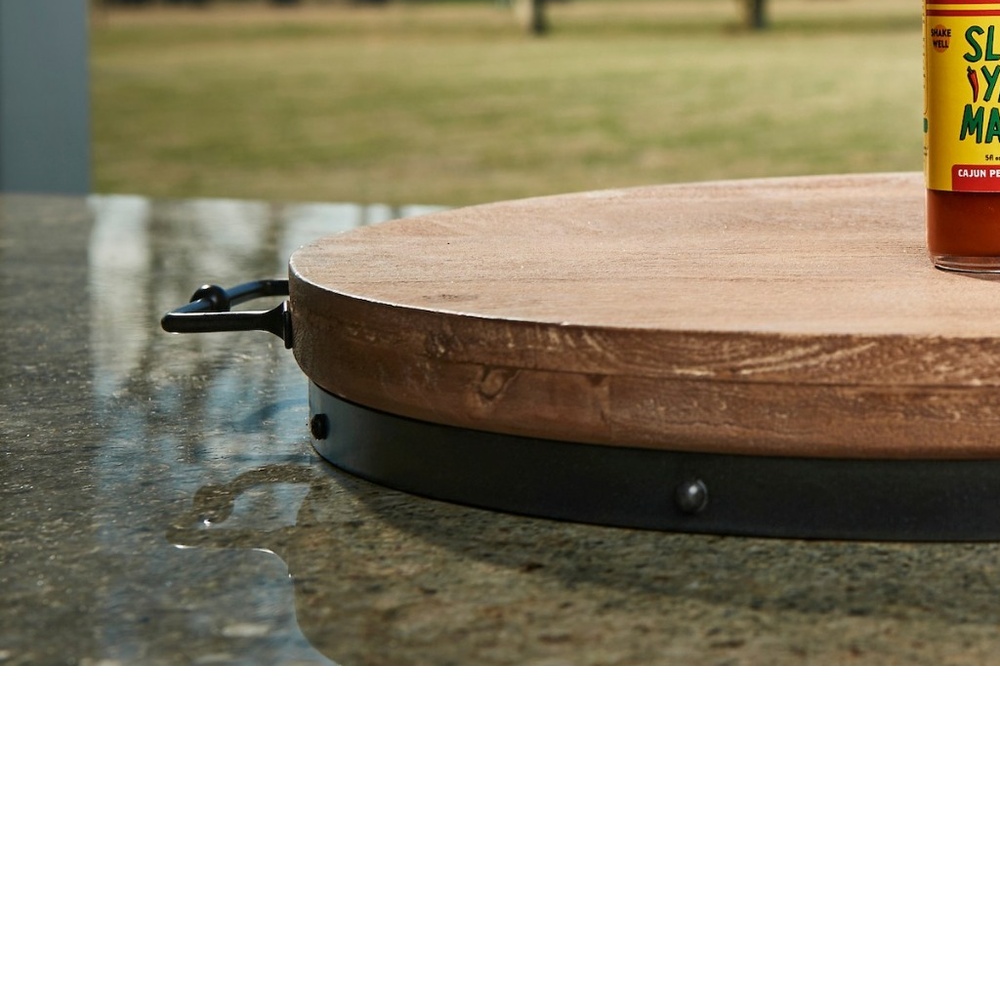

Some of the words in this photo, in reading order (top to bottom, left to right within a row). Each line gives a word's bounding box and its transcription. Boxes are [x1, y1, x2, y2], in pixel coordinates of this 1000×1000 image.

[930, 28, 952, 38] SHAKE
[932, 39, 950, 49] WELL
[957, 168, 987, 178] CAJUN
